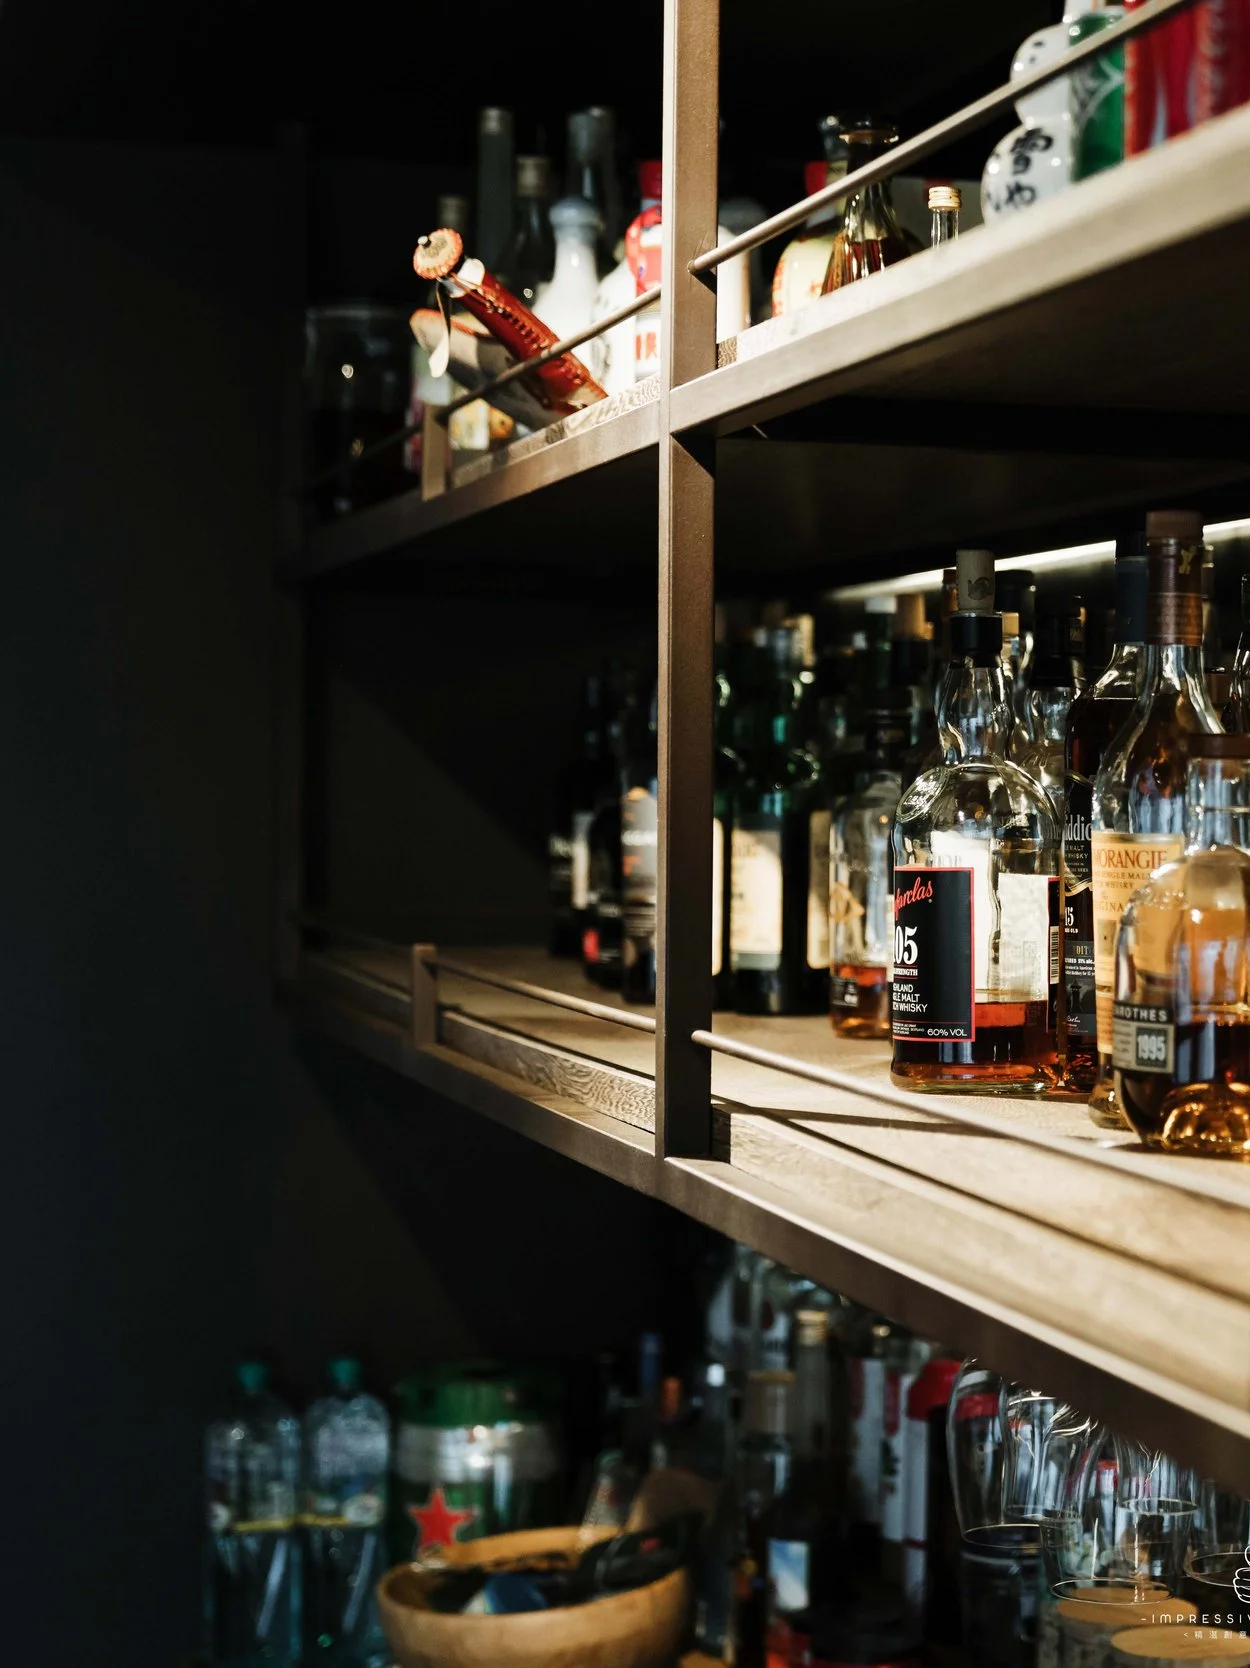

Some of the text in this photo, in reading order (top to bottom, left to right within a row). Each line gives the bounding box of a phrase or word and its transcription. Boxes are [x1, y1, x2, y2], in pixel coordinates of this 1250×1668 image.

[901, 994, 920, 1003] MALT
[899, 1003, 928, 1013] WHISKY
[1116, 1006, 1167, 1022] ROTHES
[927, 1028, 949, 1037] 60%
